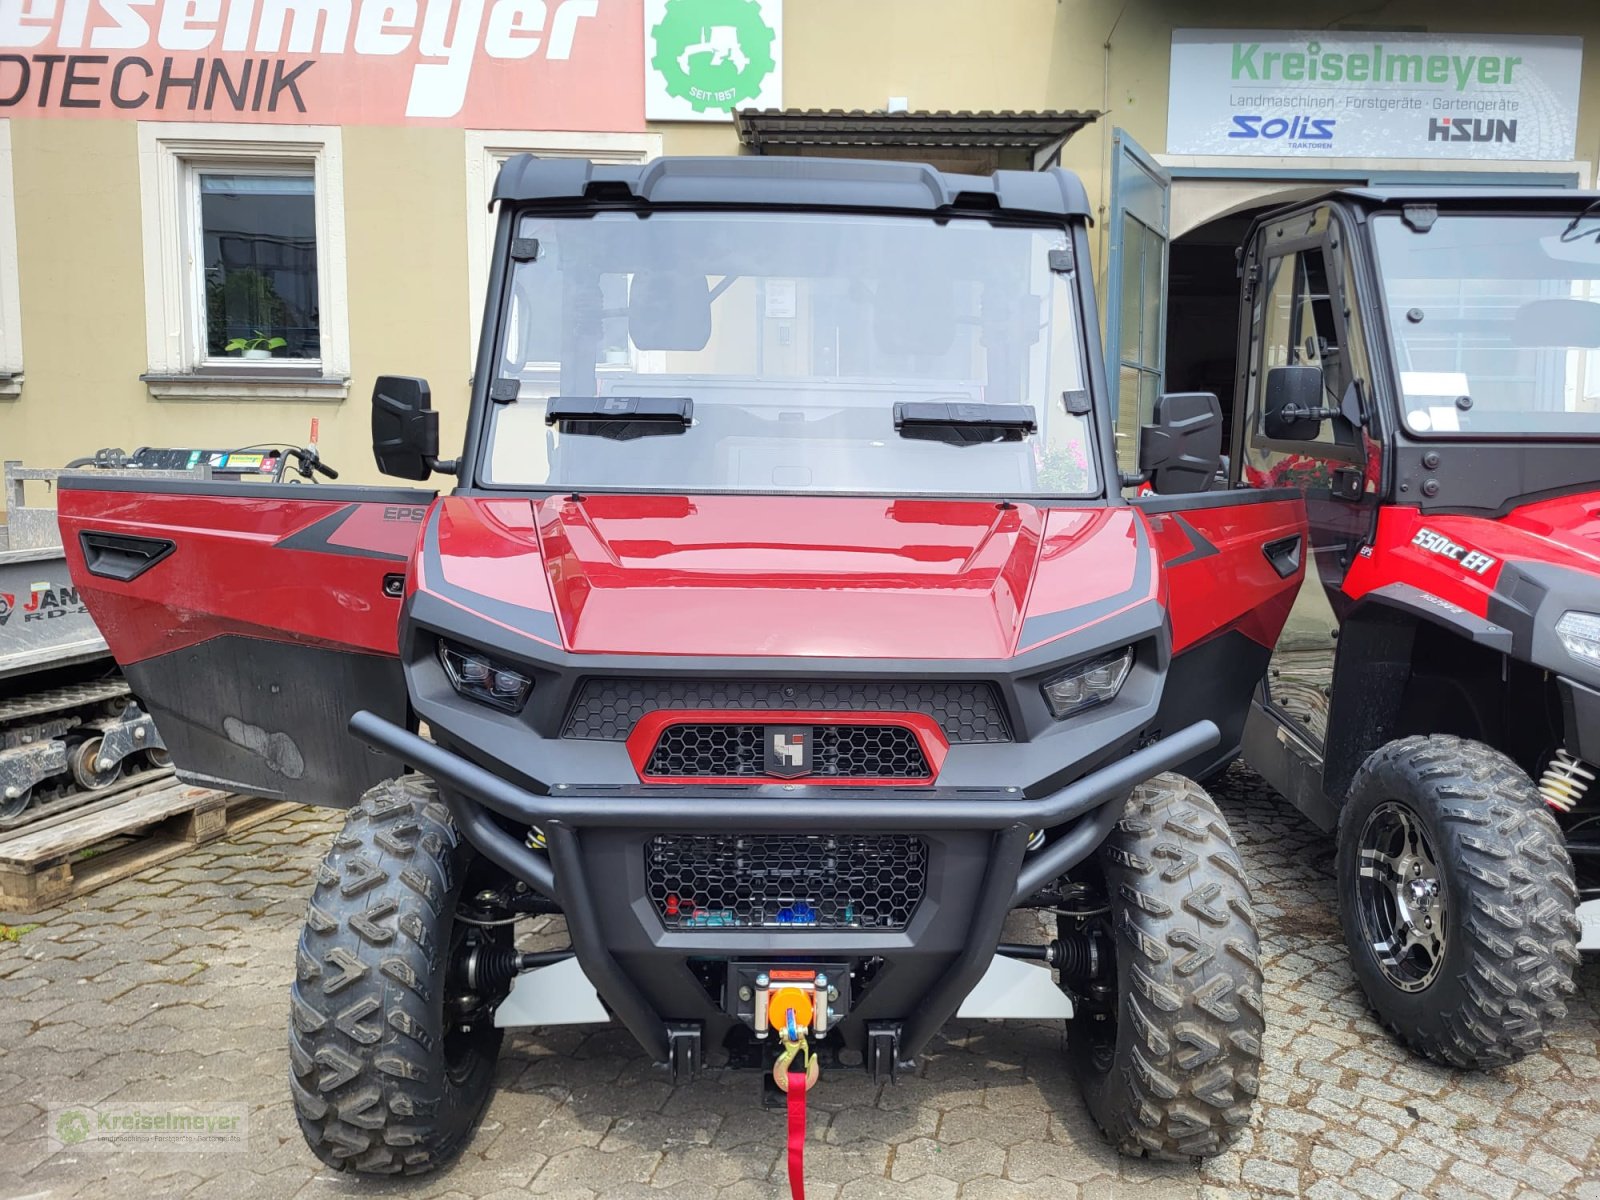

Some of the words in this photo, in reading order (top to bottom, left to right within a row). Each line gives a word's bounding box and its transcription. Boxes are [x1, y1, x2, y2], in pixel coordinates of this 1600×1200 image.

[1231, 41, 1523, 91] Kreiselmeyer
[689, 86, 712, 101] SEIT
[714, 87, 736, 102] 1857
[1229, 94, 1335, 108] Landmaschinen
[1345, 96, 1422, 111] Forstgeräte
[1432, 98, 1519, 112] Gartengeräte
[1288, 142, 1333, 150] TRAKTOREN
[384, 507, 426, 521] EPS
[1411, 528, 1465, 560] 550cc
[1459, 550, 1496, 576] EFI
